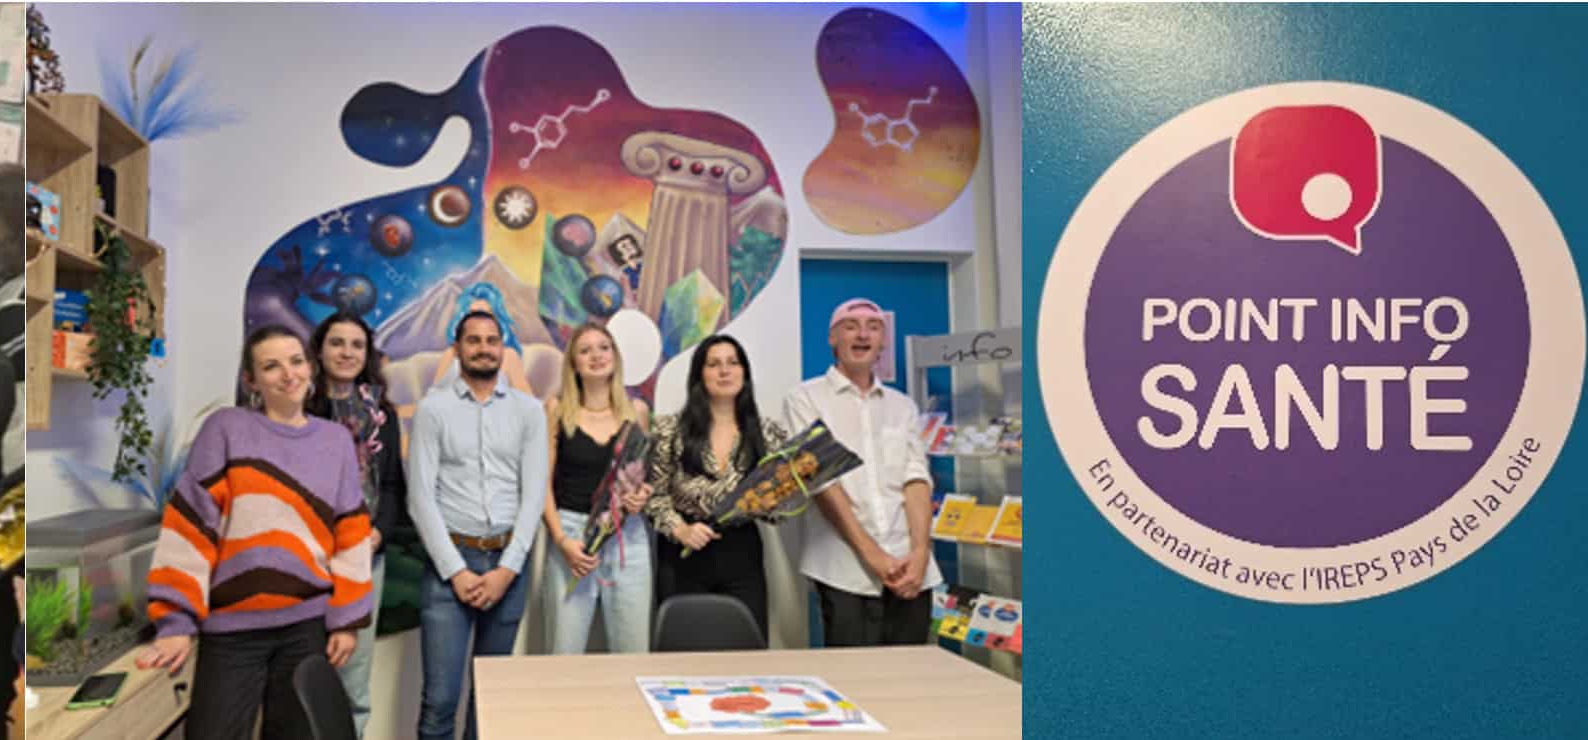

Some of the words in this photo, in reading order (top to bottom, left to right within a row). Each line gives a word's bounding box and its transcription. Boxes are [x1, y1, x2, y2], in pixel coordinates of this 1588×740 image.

[942, 331, 1013, 362] info
[1141, 296, 1318, 342] POINT
[1330, 296, 1470, 342] INFO
[1136, 344, 1474, 451] SANTÉ
[1088, 457, 1115, 492] En
[1106, 490, 1233, 579] partenariat
[1235, 565, 1296, 590] avec
[1302, 557, 1388, 591] l'IREPS
[1390, 535, 1447, 575] Pays
[1449, 513, 1481, 542] de
[1472, 494, 1502, 517] la
[1490, 436, 1541, 495] Loire
